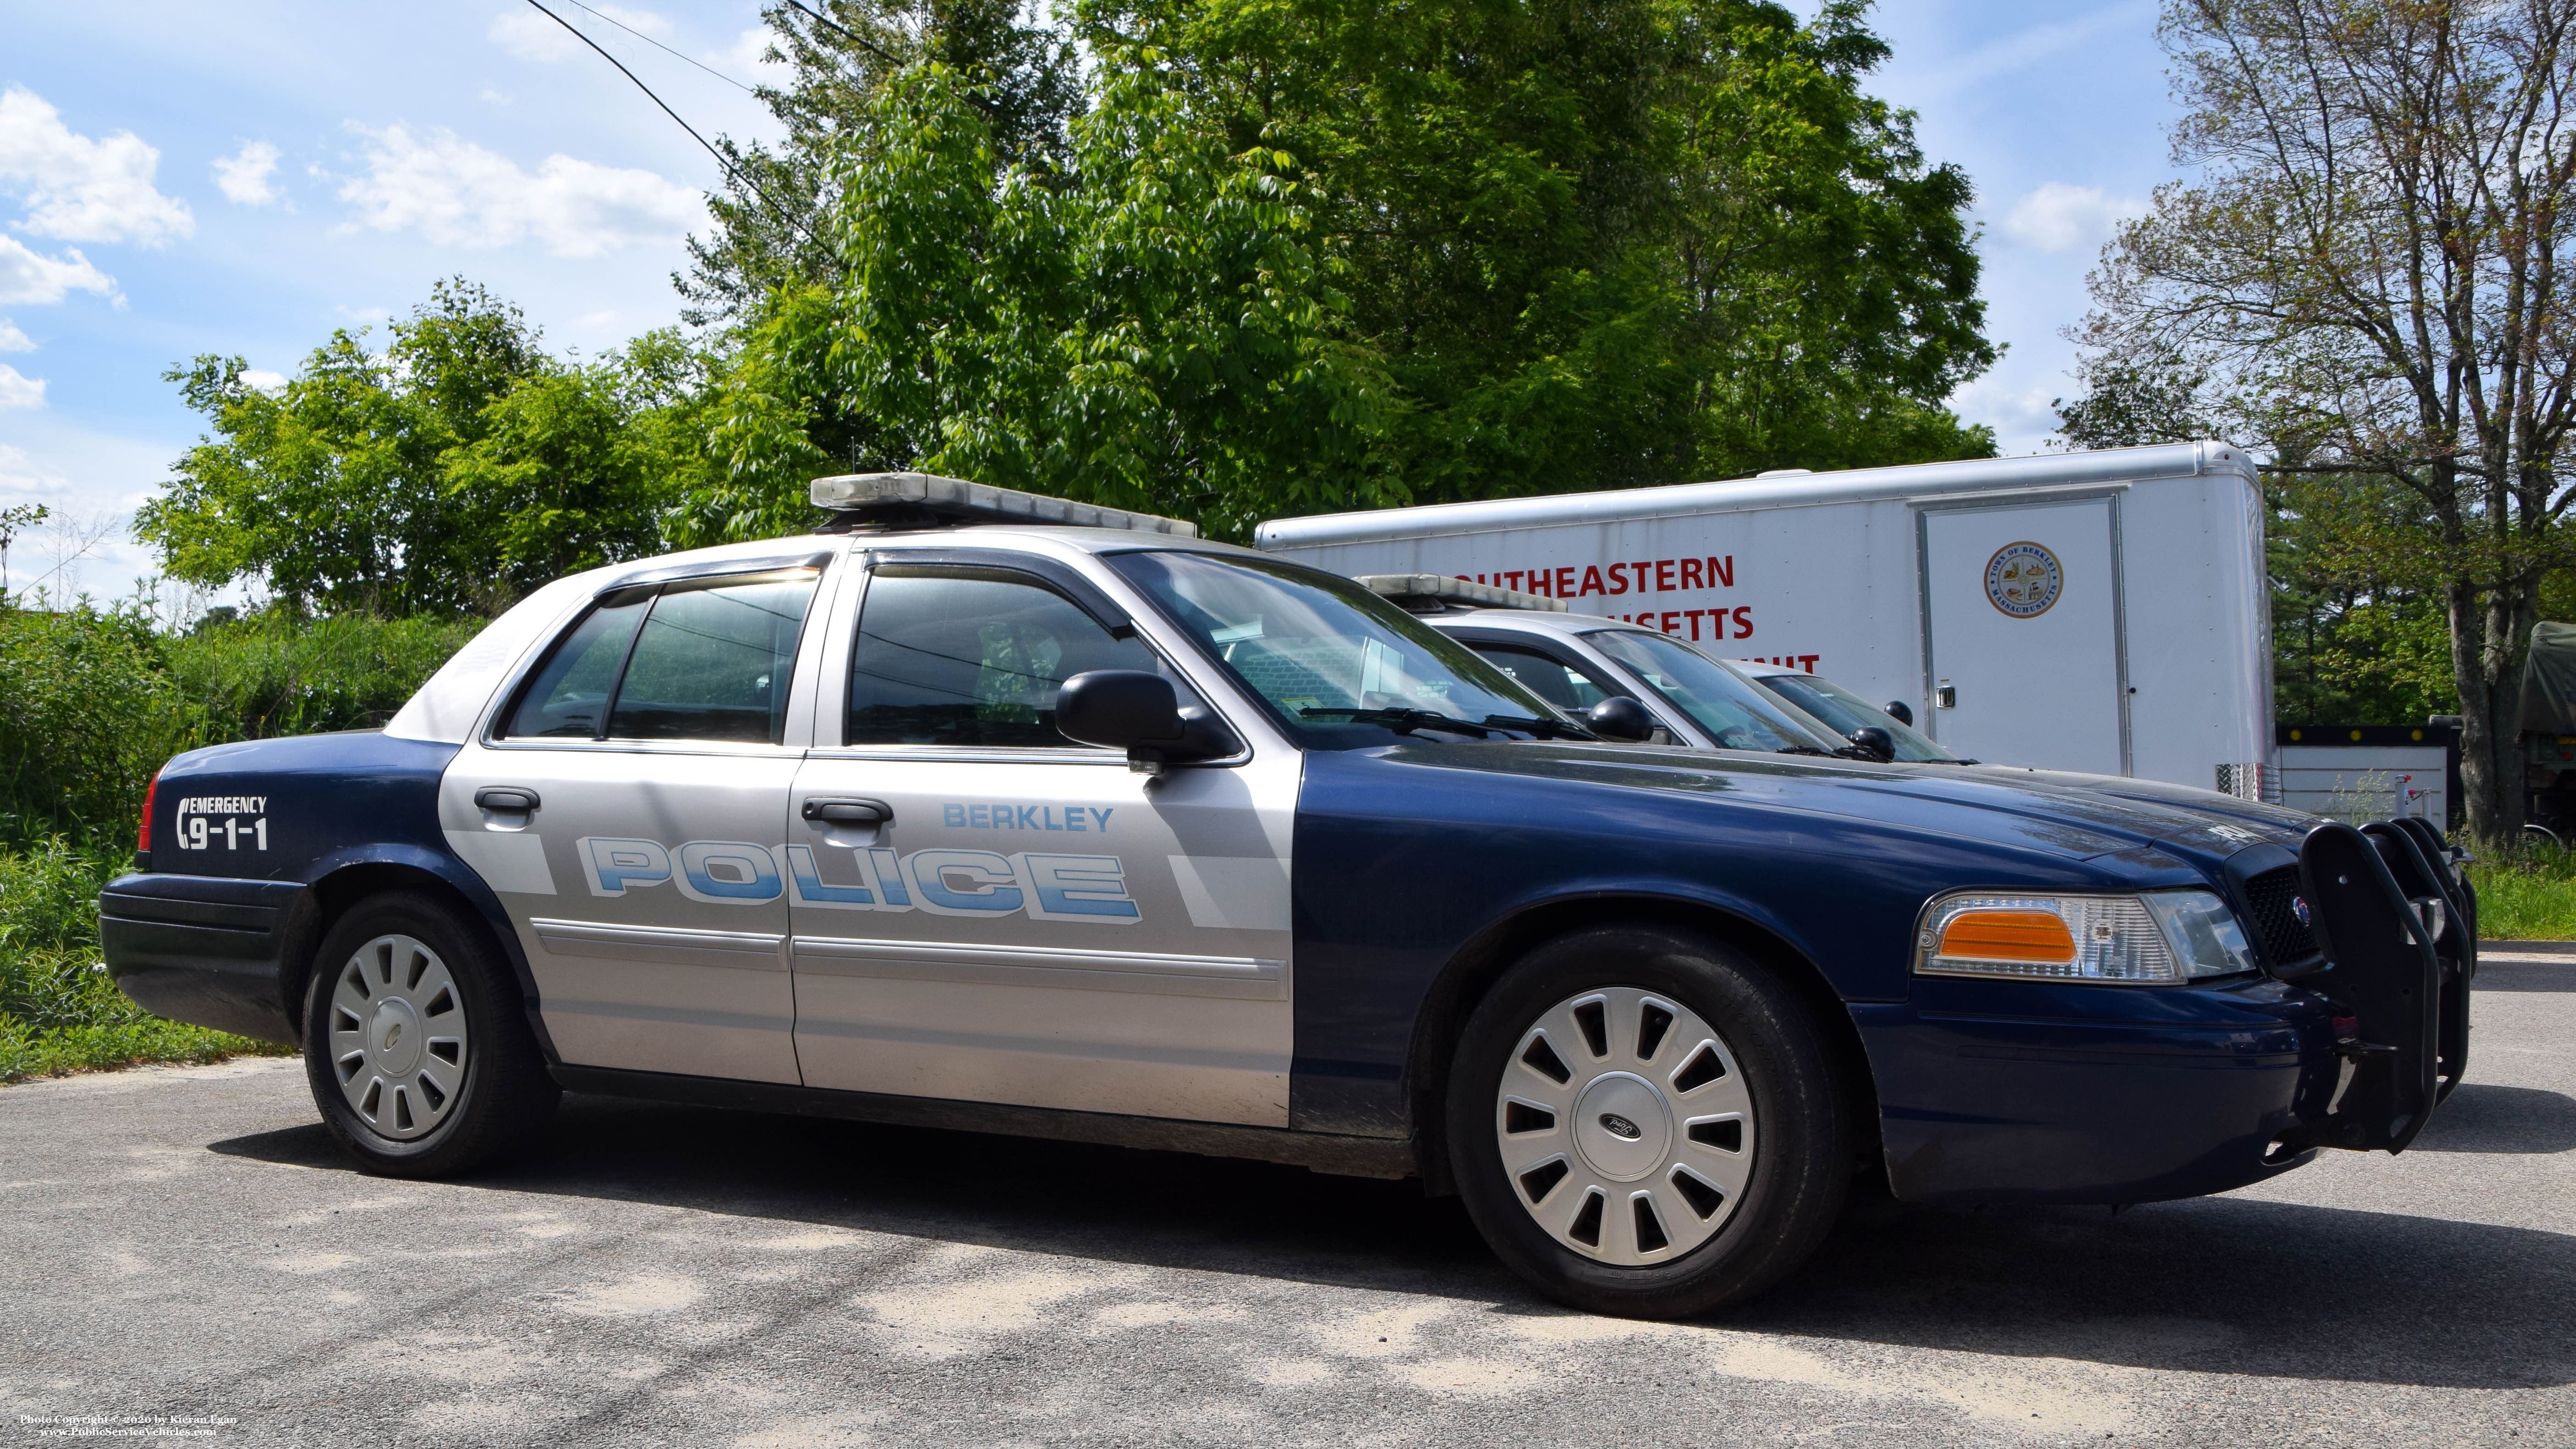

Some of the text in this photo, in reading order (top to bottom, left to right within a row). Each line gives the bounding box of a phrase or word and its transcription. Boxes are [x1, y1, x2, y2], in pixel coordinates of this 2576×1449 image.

[1990, 546, 2057, 577] TOWN OF BERKLEY
[1991, 585, 2057, 613] MASSACHUSETTS
[190, 796, 267, 814] EMERGENCY
[943, 802, 1114, 833] BERKLEY
[190, 818, 267, 850] 9-1-1
[576, 836, 1144, 925] POLICE
[1610, 1119, 1632, 1134] Ford
